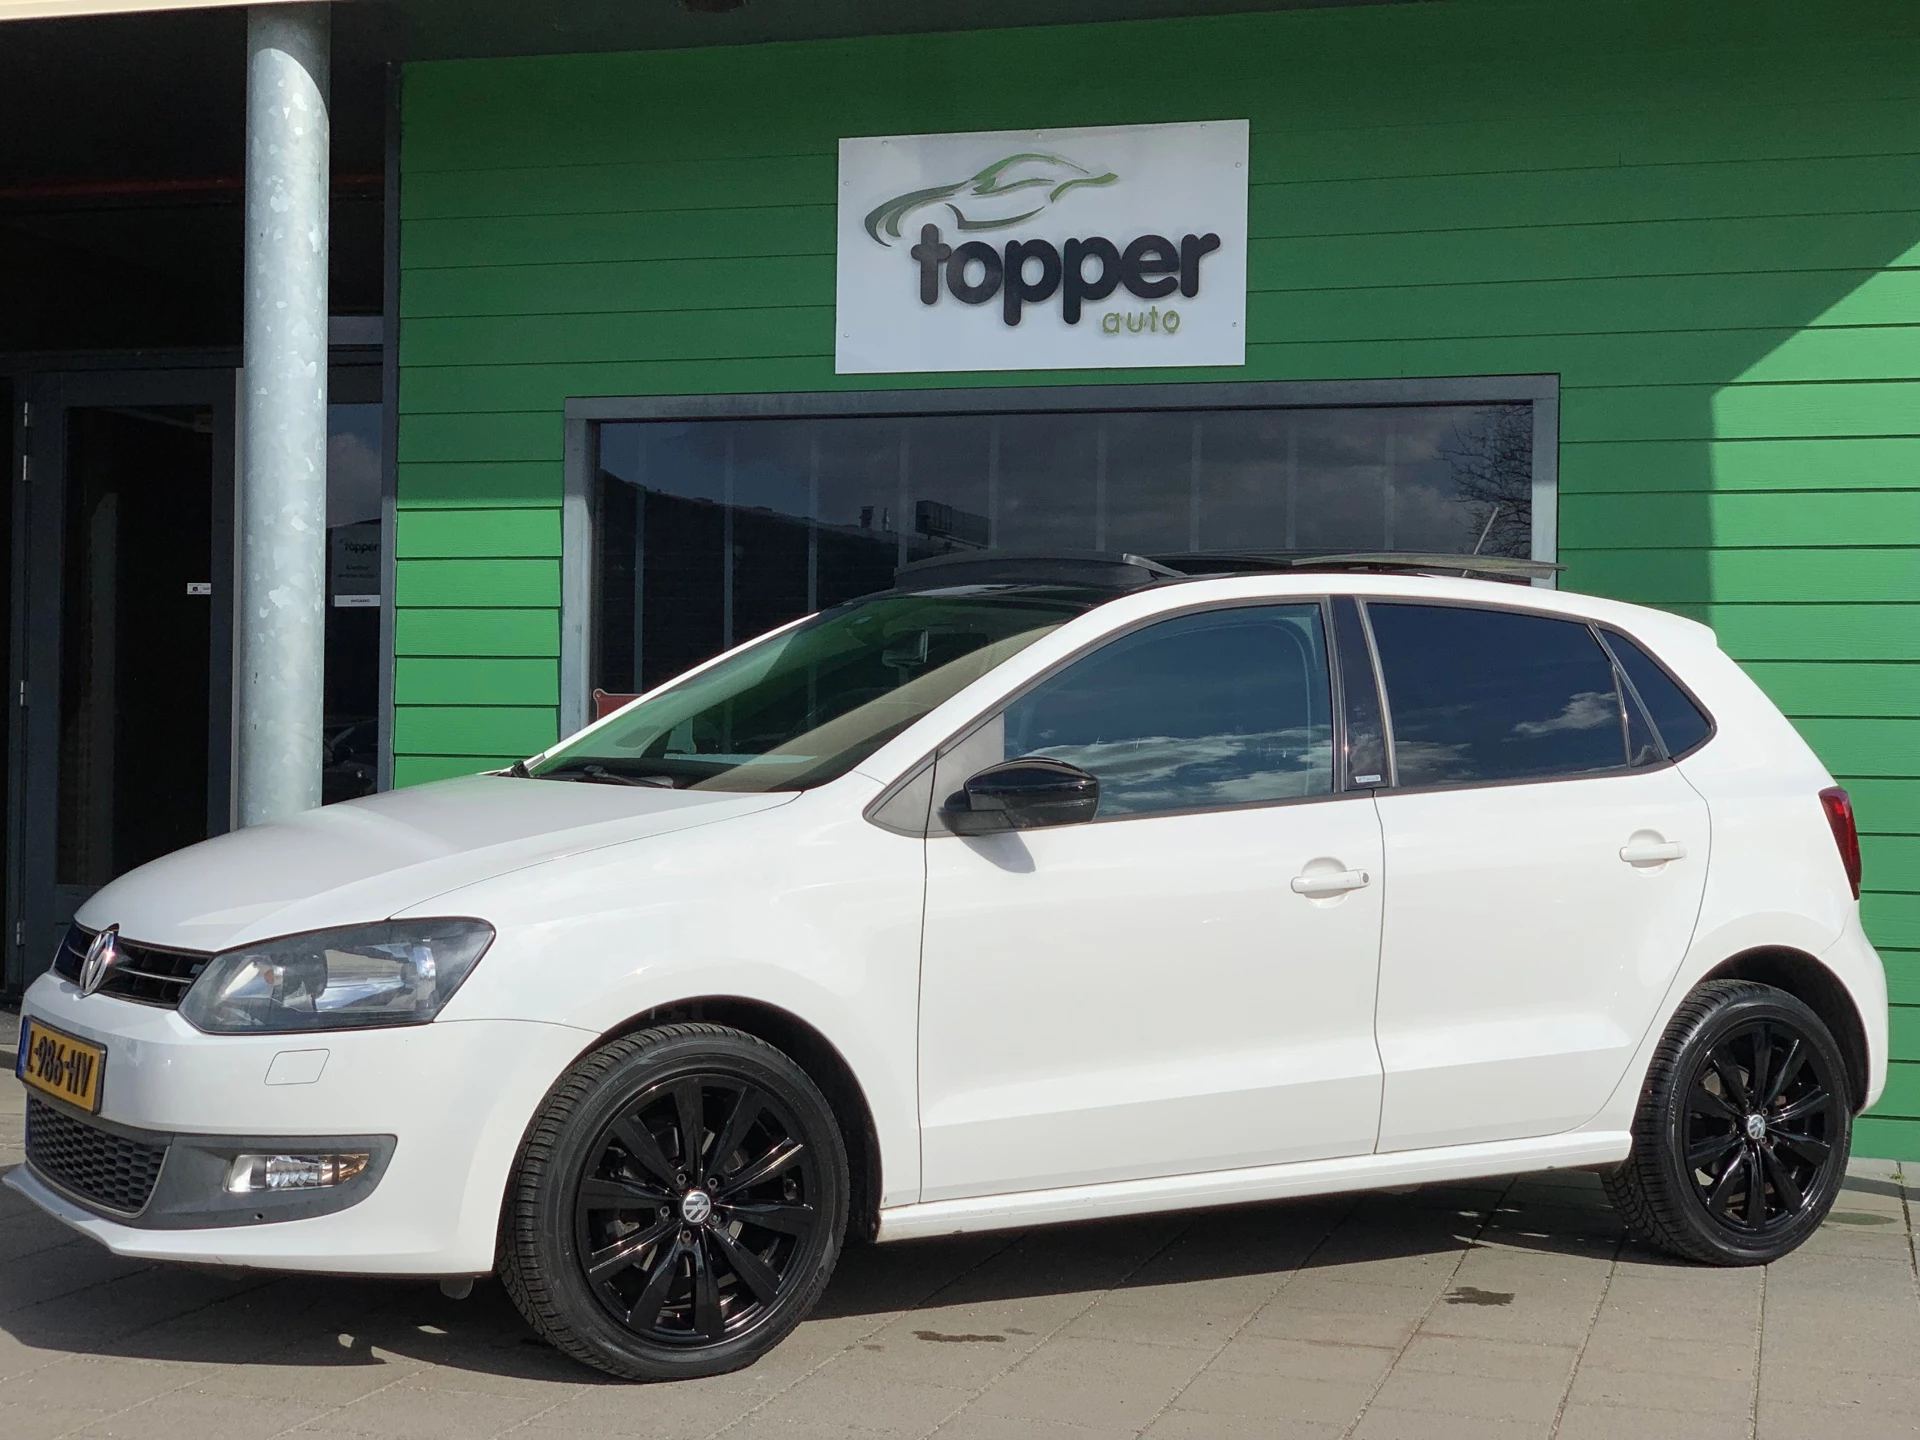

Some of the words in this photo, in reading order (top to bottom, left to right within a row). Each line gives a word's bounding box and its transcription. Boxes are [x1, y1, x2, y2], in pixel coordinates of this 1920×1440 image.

[910, 223, 1221, 327] topper
[1102, 306, 1181, 334] auto
[27, 1030, 94, 1098] L-986-HV
